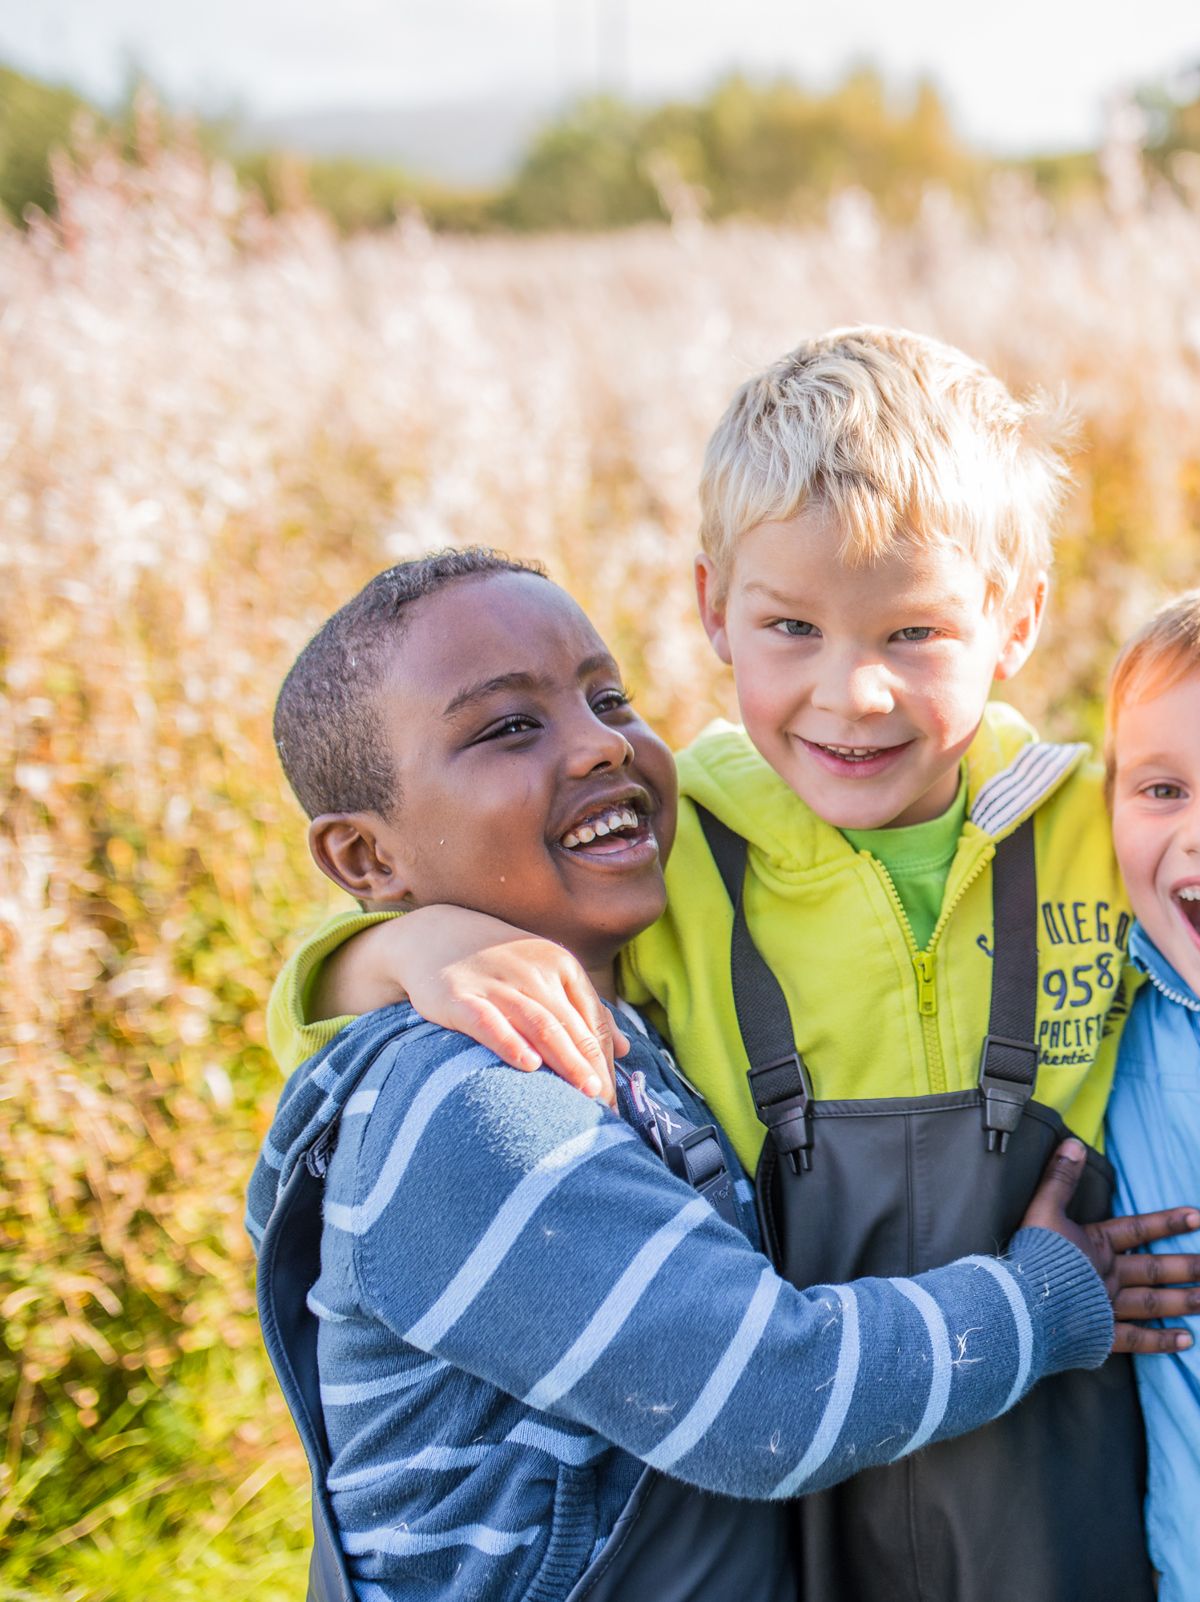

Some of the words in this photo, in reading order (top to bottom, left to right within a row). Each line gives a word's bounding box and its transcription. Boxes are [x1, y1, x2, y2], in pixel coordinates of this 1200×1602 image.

[1042, 901, 1130, 951] DIEGO
[1042, 952, 1114, 1010] 958
[1038, 1049, 1096, 1066] hentic
